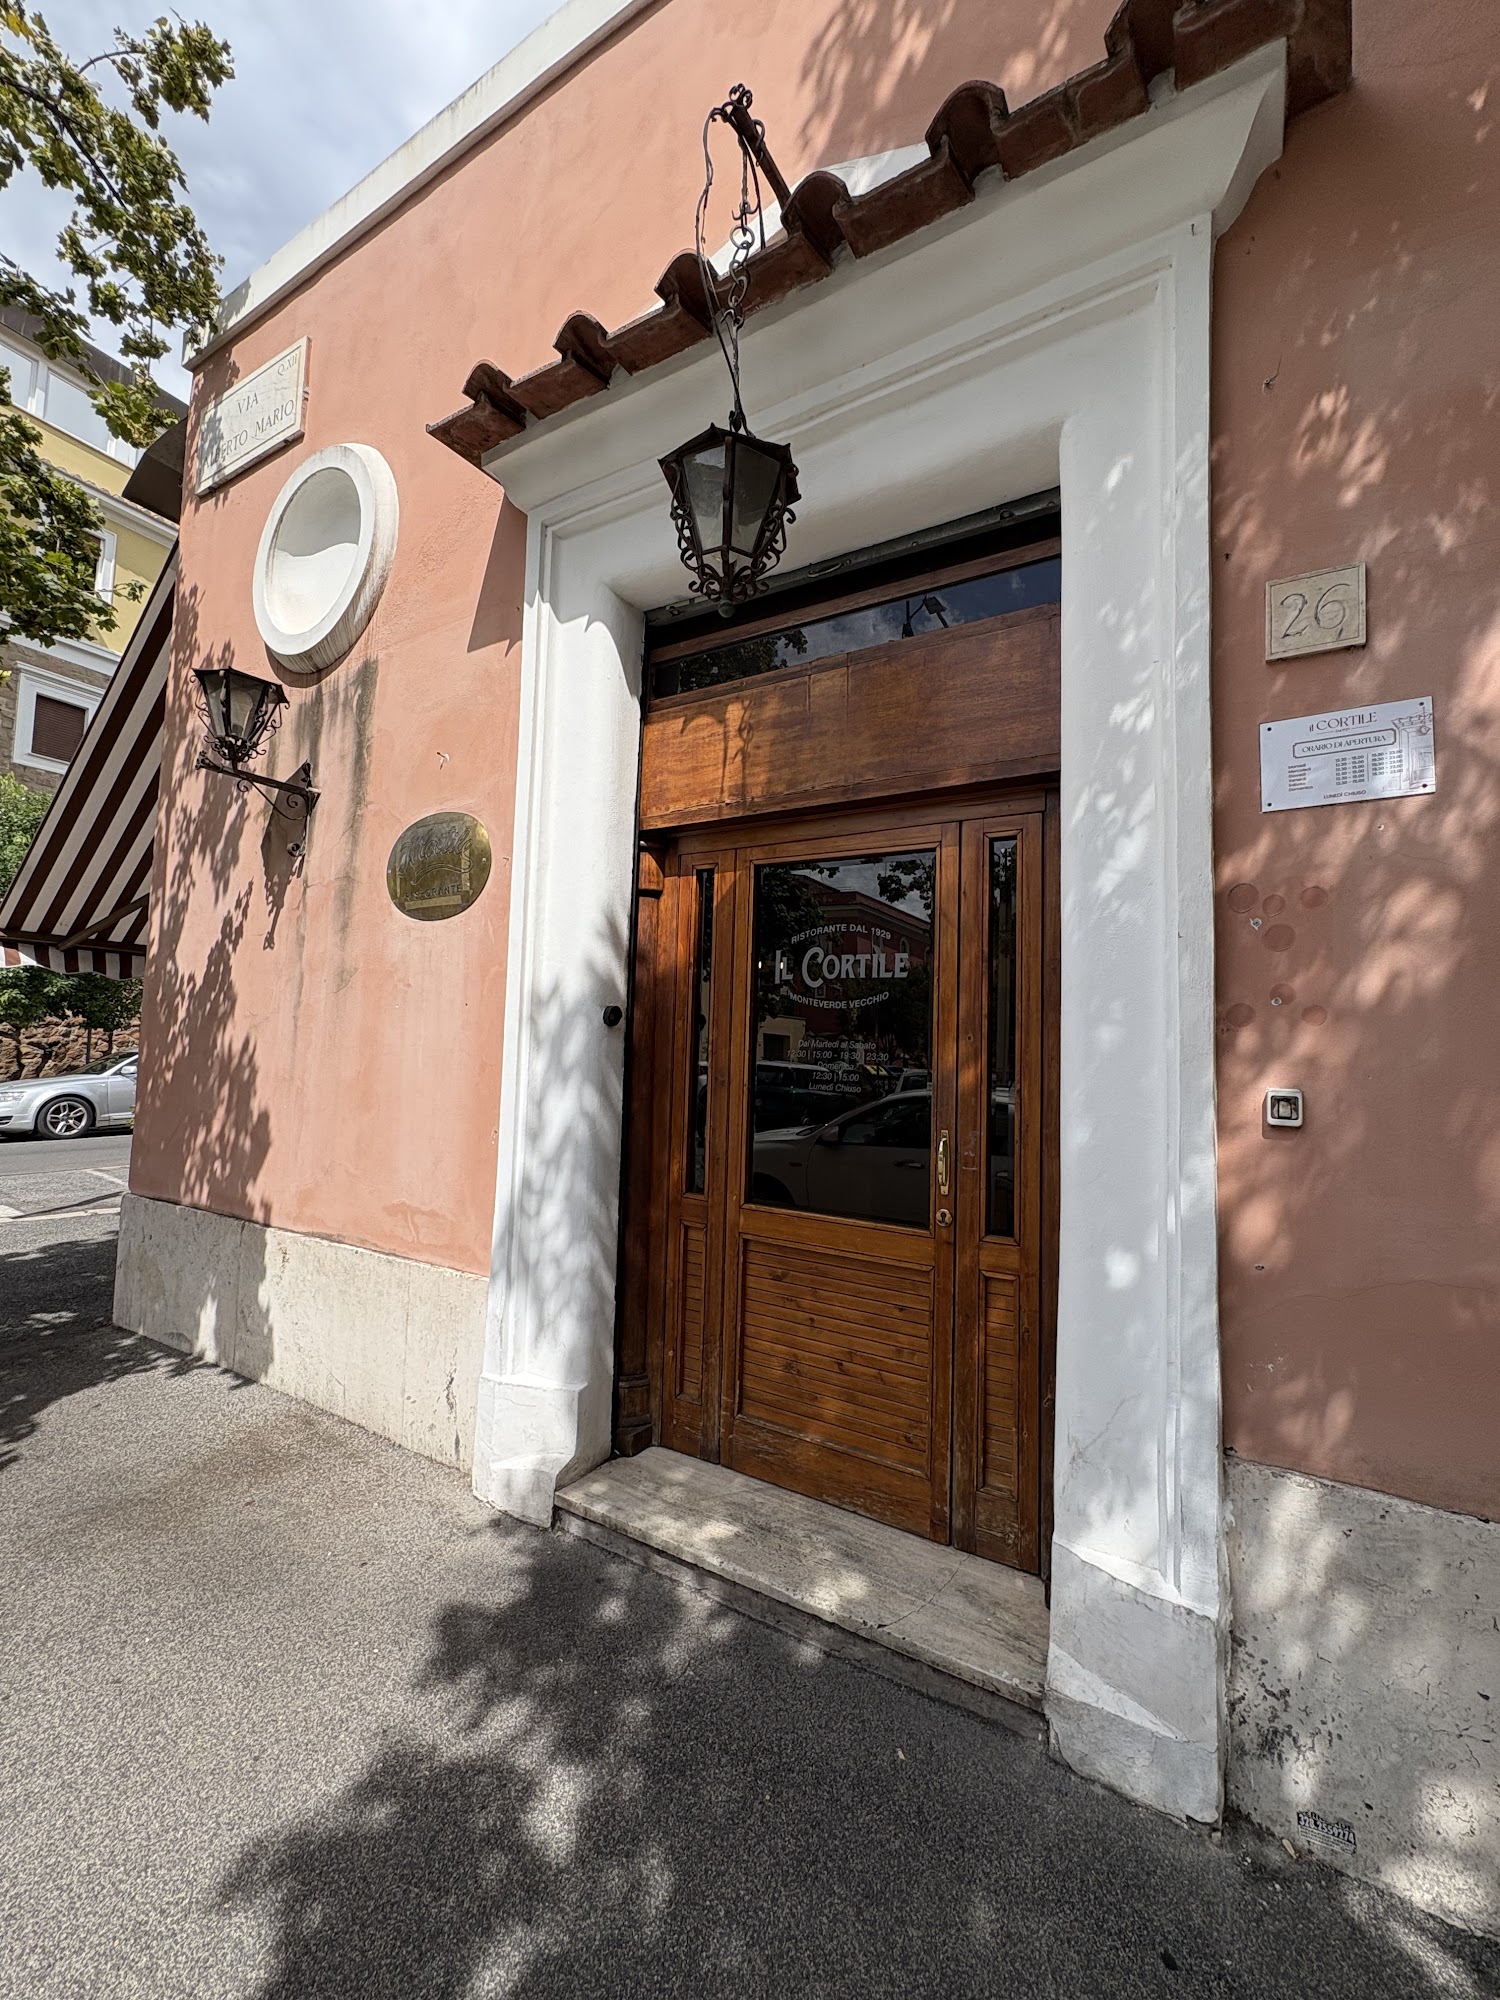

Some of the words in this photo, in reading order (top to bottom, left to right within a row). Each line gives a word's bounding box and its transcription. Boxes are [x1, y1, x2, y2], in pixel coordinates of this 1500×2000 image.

[236, 392, 259, 414] VIA
[204, 429, 249, 468] ALBERTO
[254, 399, 295, 437] MARIO
[1280, 583, 1351, 639] 26
[1316, 712, 1378, 731] CORTILE
[1302, 743, 1333, 753] ORARIO
[1334, 740, 1343, 748] DI
[1343, 735, 1387, 747] APERTURA
[1344, 789, 1367, 797] CHIUSO
[405, 883, 463, 902] RISTORANTE
[791, 924, 848, 944] RISTORANTE
[849, 923, 868, 933] DAL
[871, 927, 891, 940] 1929
[789, 992, 847, 1009] MONTEVERDE
[848, 991, 890, 1009] VECCHIO
[798, 1039, 810, 1048] Dal
[840, 1040, 848, 1048] al
[849, 1041, 876, 1049] Sabato
[787, 1050, 806, 1058] 12:30
[812, 1051, 832, 1059] 15:00
[840, 1051, 860, 1060] 19:30
[866, 1053, 889, 1061] 23:30
[812, 1072, 832, 1080] 12:30
[839, 1073, 859, 1082] 15:00
[835, 1083, 862, 1093] Chiuso
